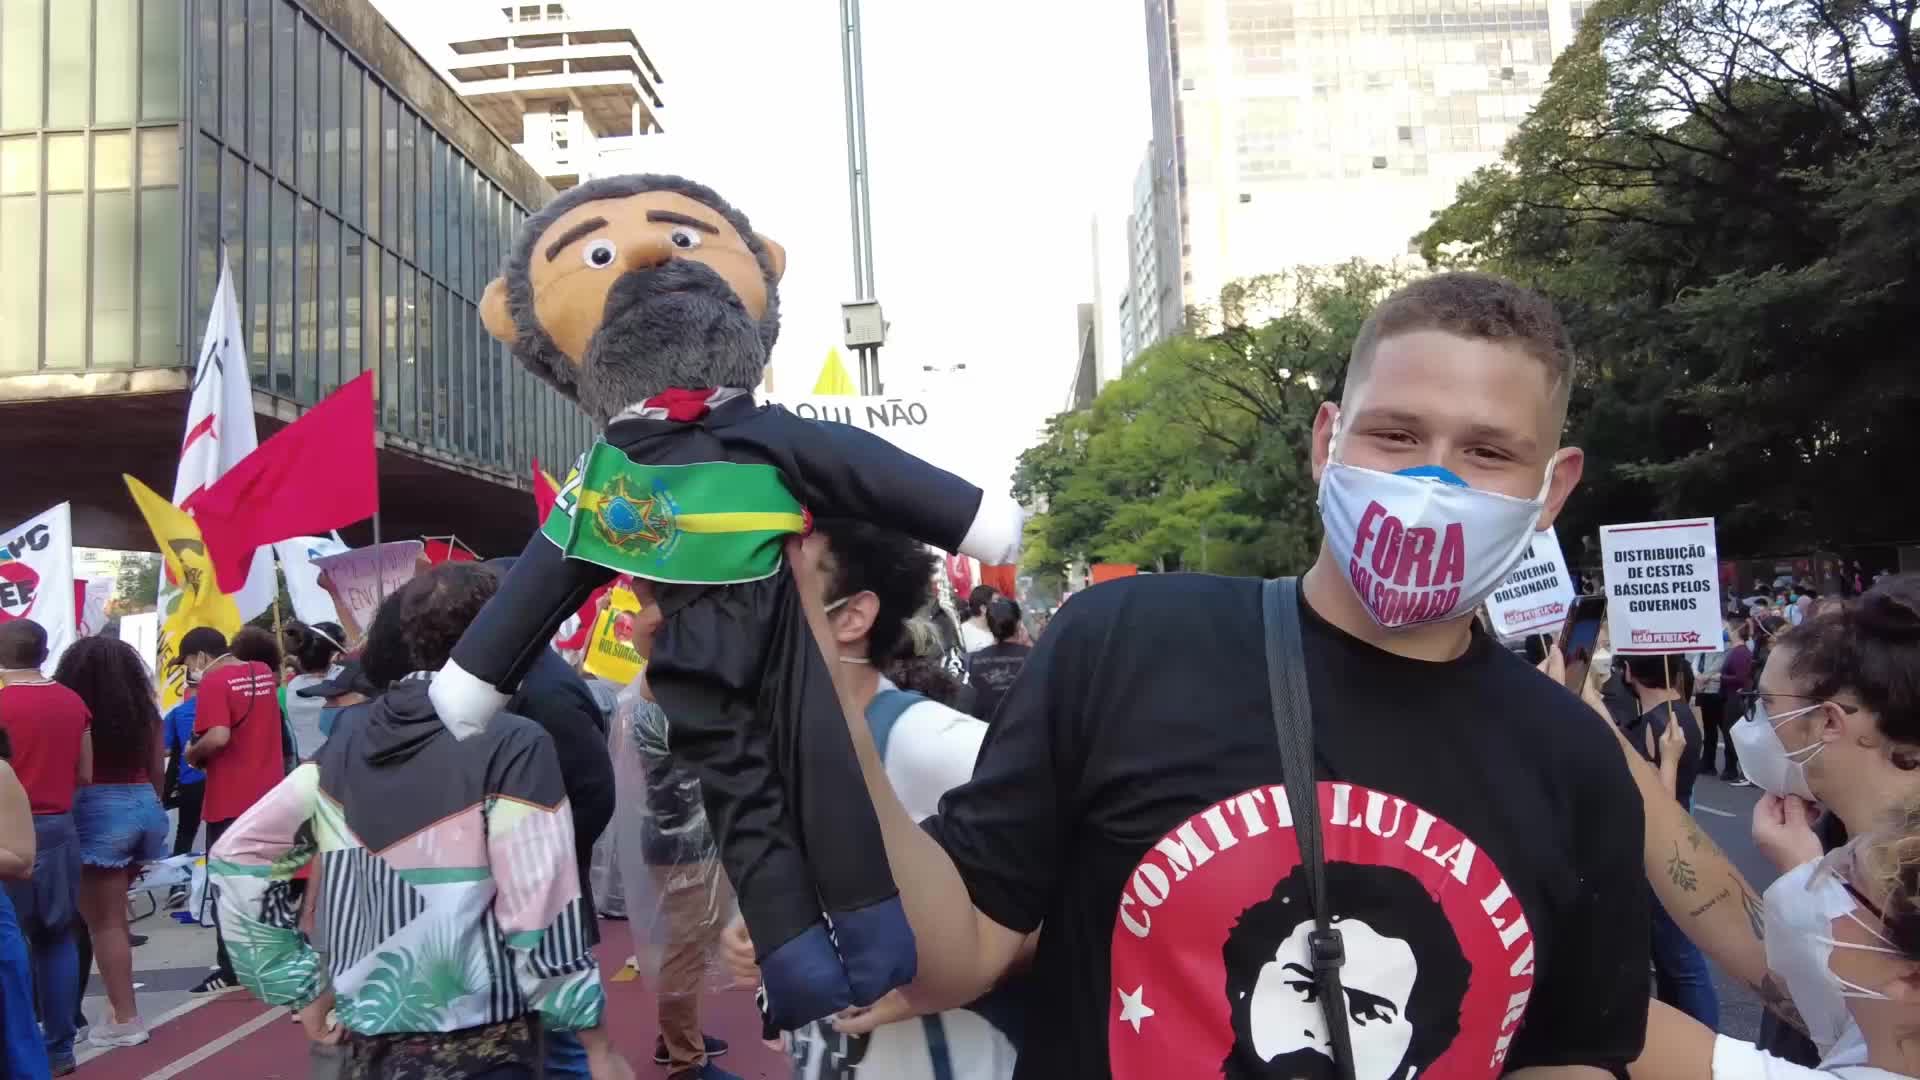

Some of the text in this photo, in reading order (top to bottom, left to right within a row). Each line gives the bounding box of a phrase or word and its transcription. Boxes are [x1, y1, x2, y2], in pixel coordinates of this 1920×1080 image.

[866, 399, 927, 428] NÃO
[1353, 500, 1465, 587] FORA
[1614, 544, 1706, 563] DISTRIBUIÇÃO
[1628, 564, 1694, 579] DE CESTAS
[1350, 555, 1461, 624] BOLSONARO
[1494, 576, 1559, 603] BOLSONARO
[1614, 580, 1711, 596] BÁSICAS PELOS
[1630, 598, 1697, 612] GOVERNOS
[1330, 783, 1476, 885] LULA
[1480, 878, 1534, 1068] LIVRE
